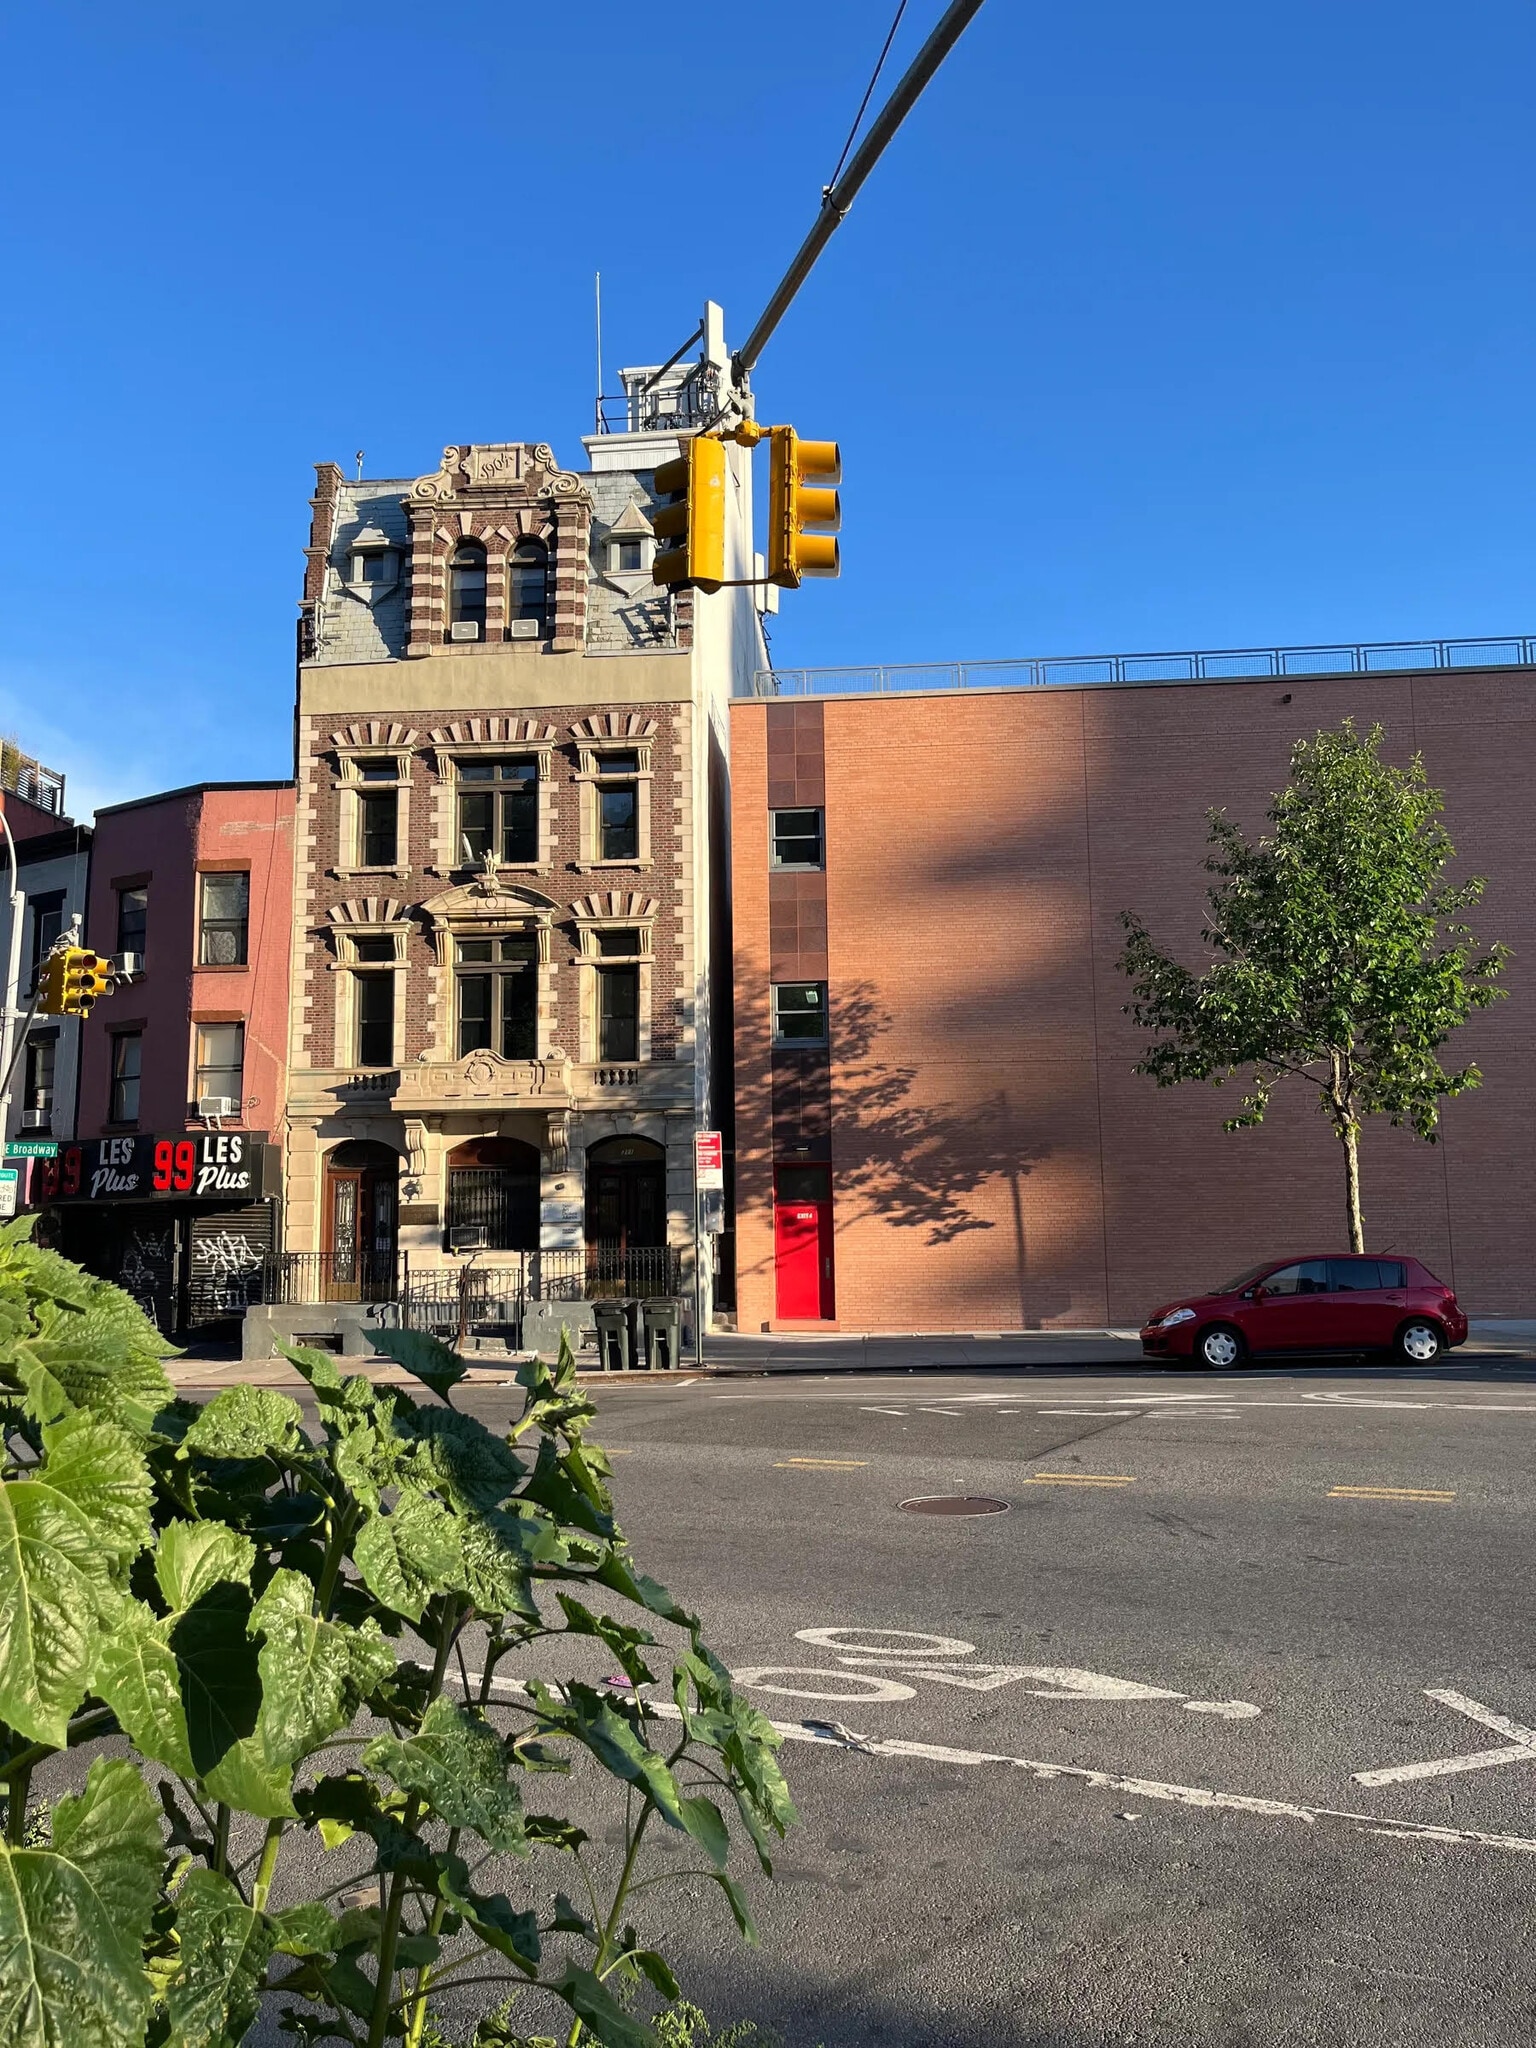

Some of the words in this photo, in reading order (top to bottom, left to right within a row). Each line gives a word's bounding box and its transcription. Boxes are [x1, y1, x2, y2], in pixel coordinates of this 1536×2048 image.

[5, 1144, 10, 1154] E
[13, 1144, 56, 1157] Broadway
[100, 1138, 135, 1165] LES
[203, 1136, 242, 1163] LES
[153, 1140, 195, 1190] 99
[91, 1167, 139, 1198] Plus
[196, 1166, 250, 1194] Plus
